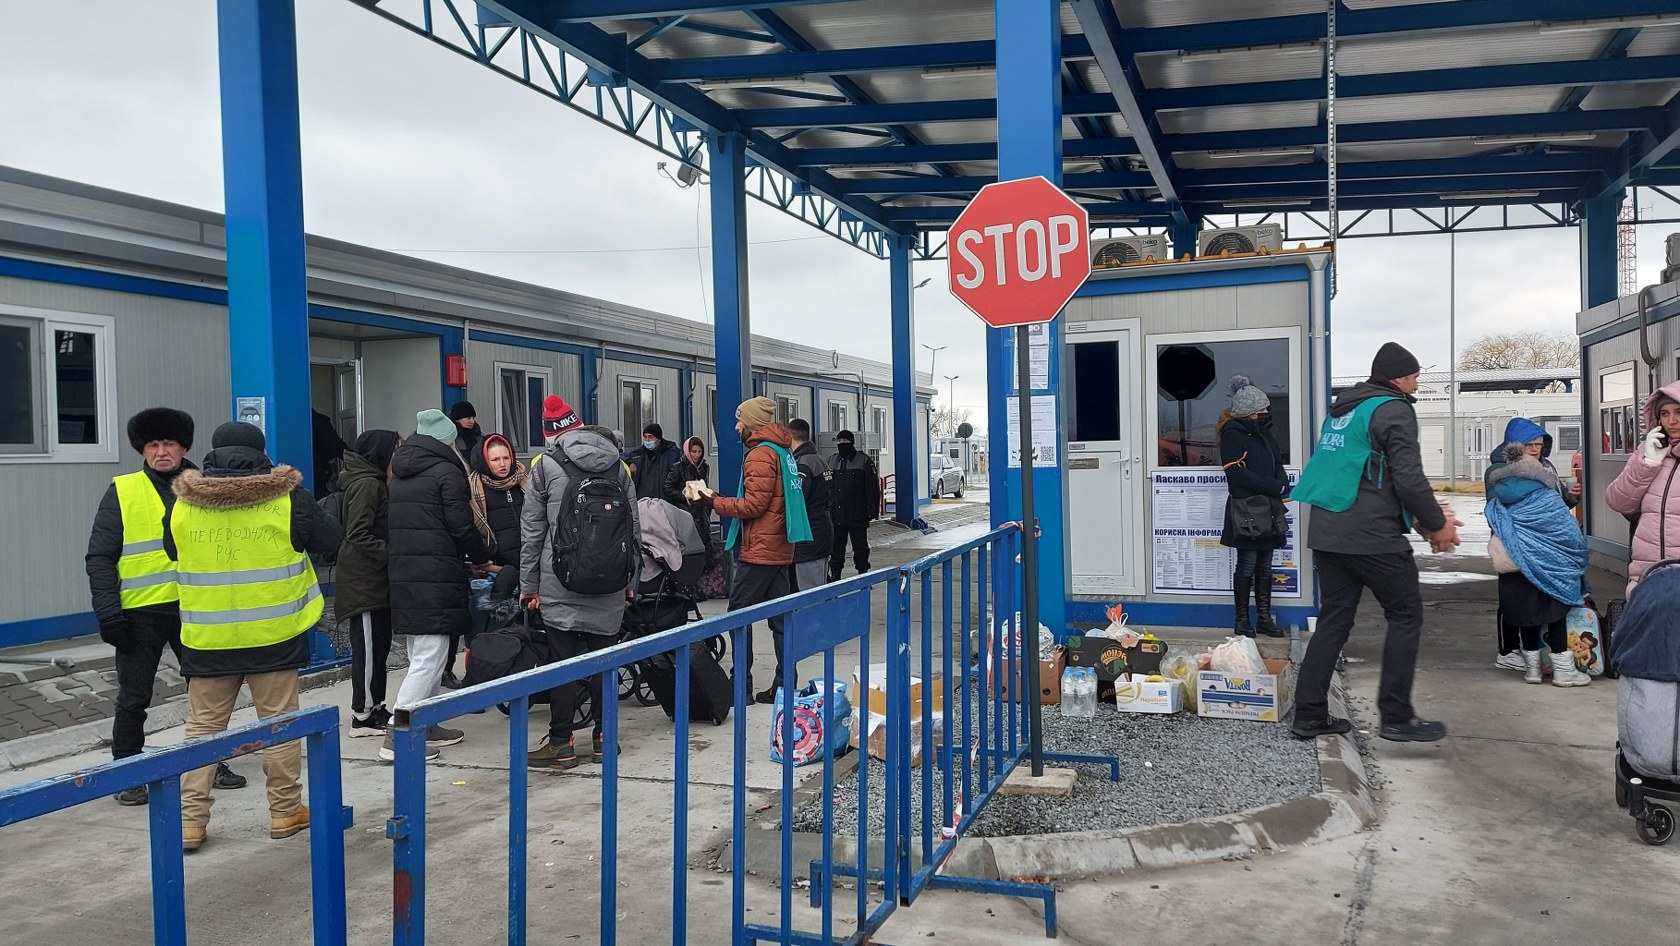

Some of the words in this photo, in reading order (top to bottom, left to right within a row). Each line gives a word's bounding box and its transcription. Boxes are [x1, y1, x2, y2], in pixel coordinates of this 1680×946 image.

[956, 214, 1079, 289] STOP
[552, 413, 578, 430] NIKE
[1155, 474, 1196, 484] Ласкаво
[1197, 475, 1227, 485] проси
[189, 526, 281, 550] ПЕРЕВОДЧИК
[1154, 528, 1187, 536] КОРИСНА
[1187, 529, 1223, 537] ІНФОРМА
[1224, 677, 1251, 691] BONITA
